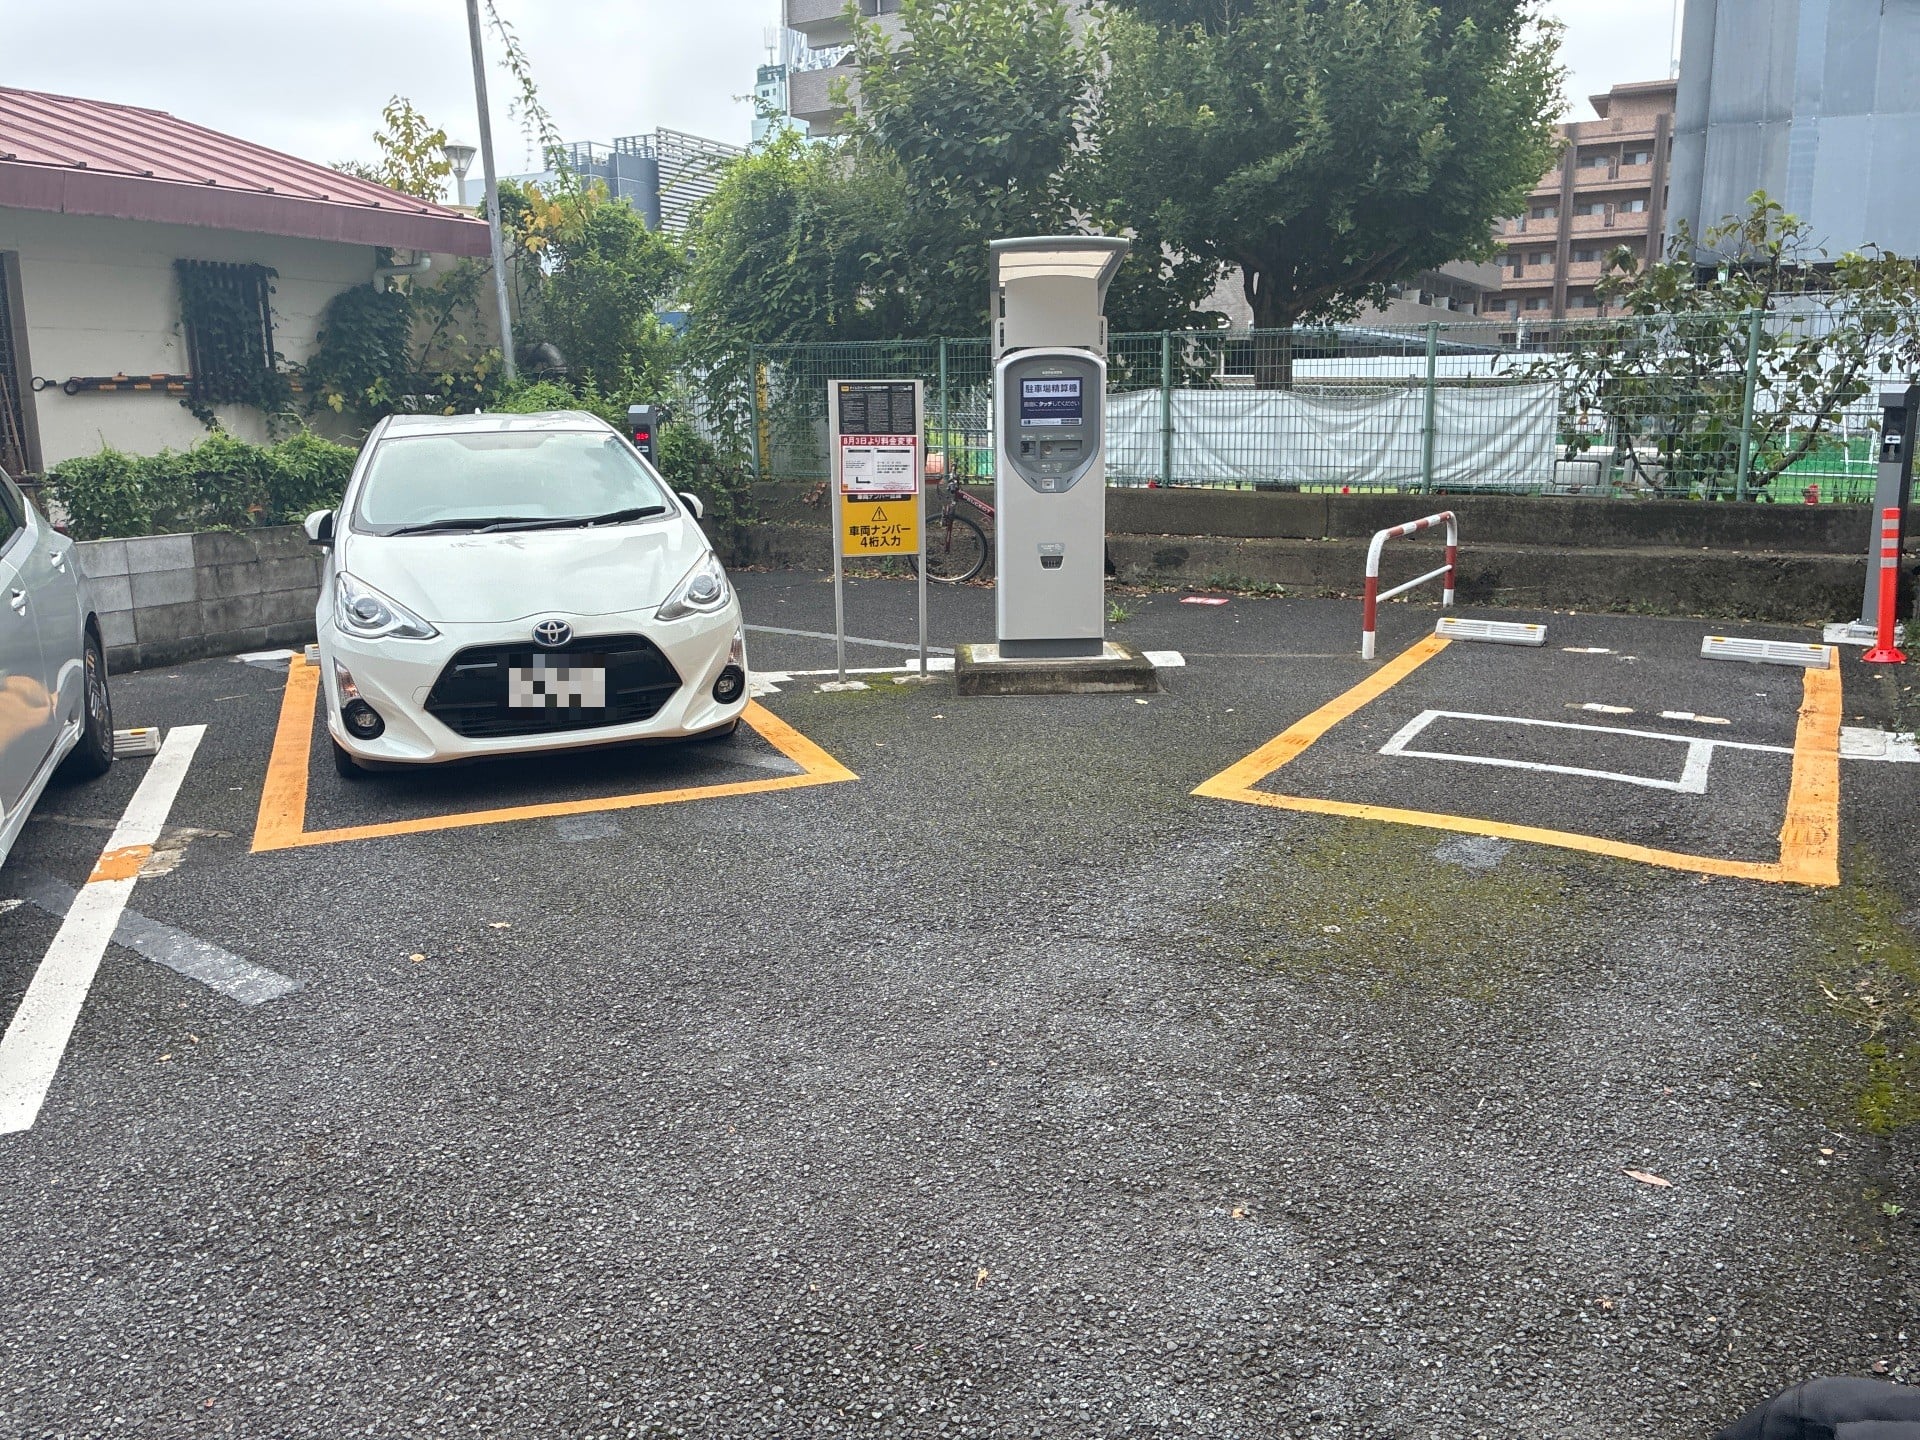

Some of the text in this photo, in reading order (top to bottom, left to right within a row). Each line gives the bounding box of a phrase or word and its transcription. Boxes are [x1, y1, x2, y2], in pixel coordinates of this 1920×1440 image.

[1025, 384, 1078, 394] 駐車場精算機
[843, 436, 914, 446] 8月3日より料金変更
[849, 524, 911, 537] 車両ナンバー
[860, 535, 902, 548] 4桁入力
